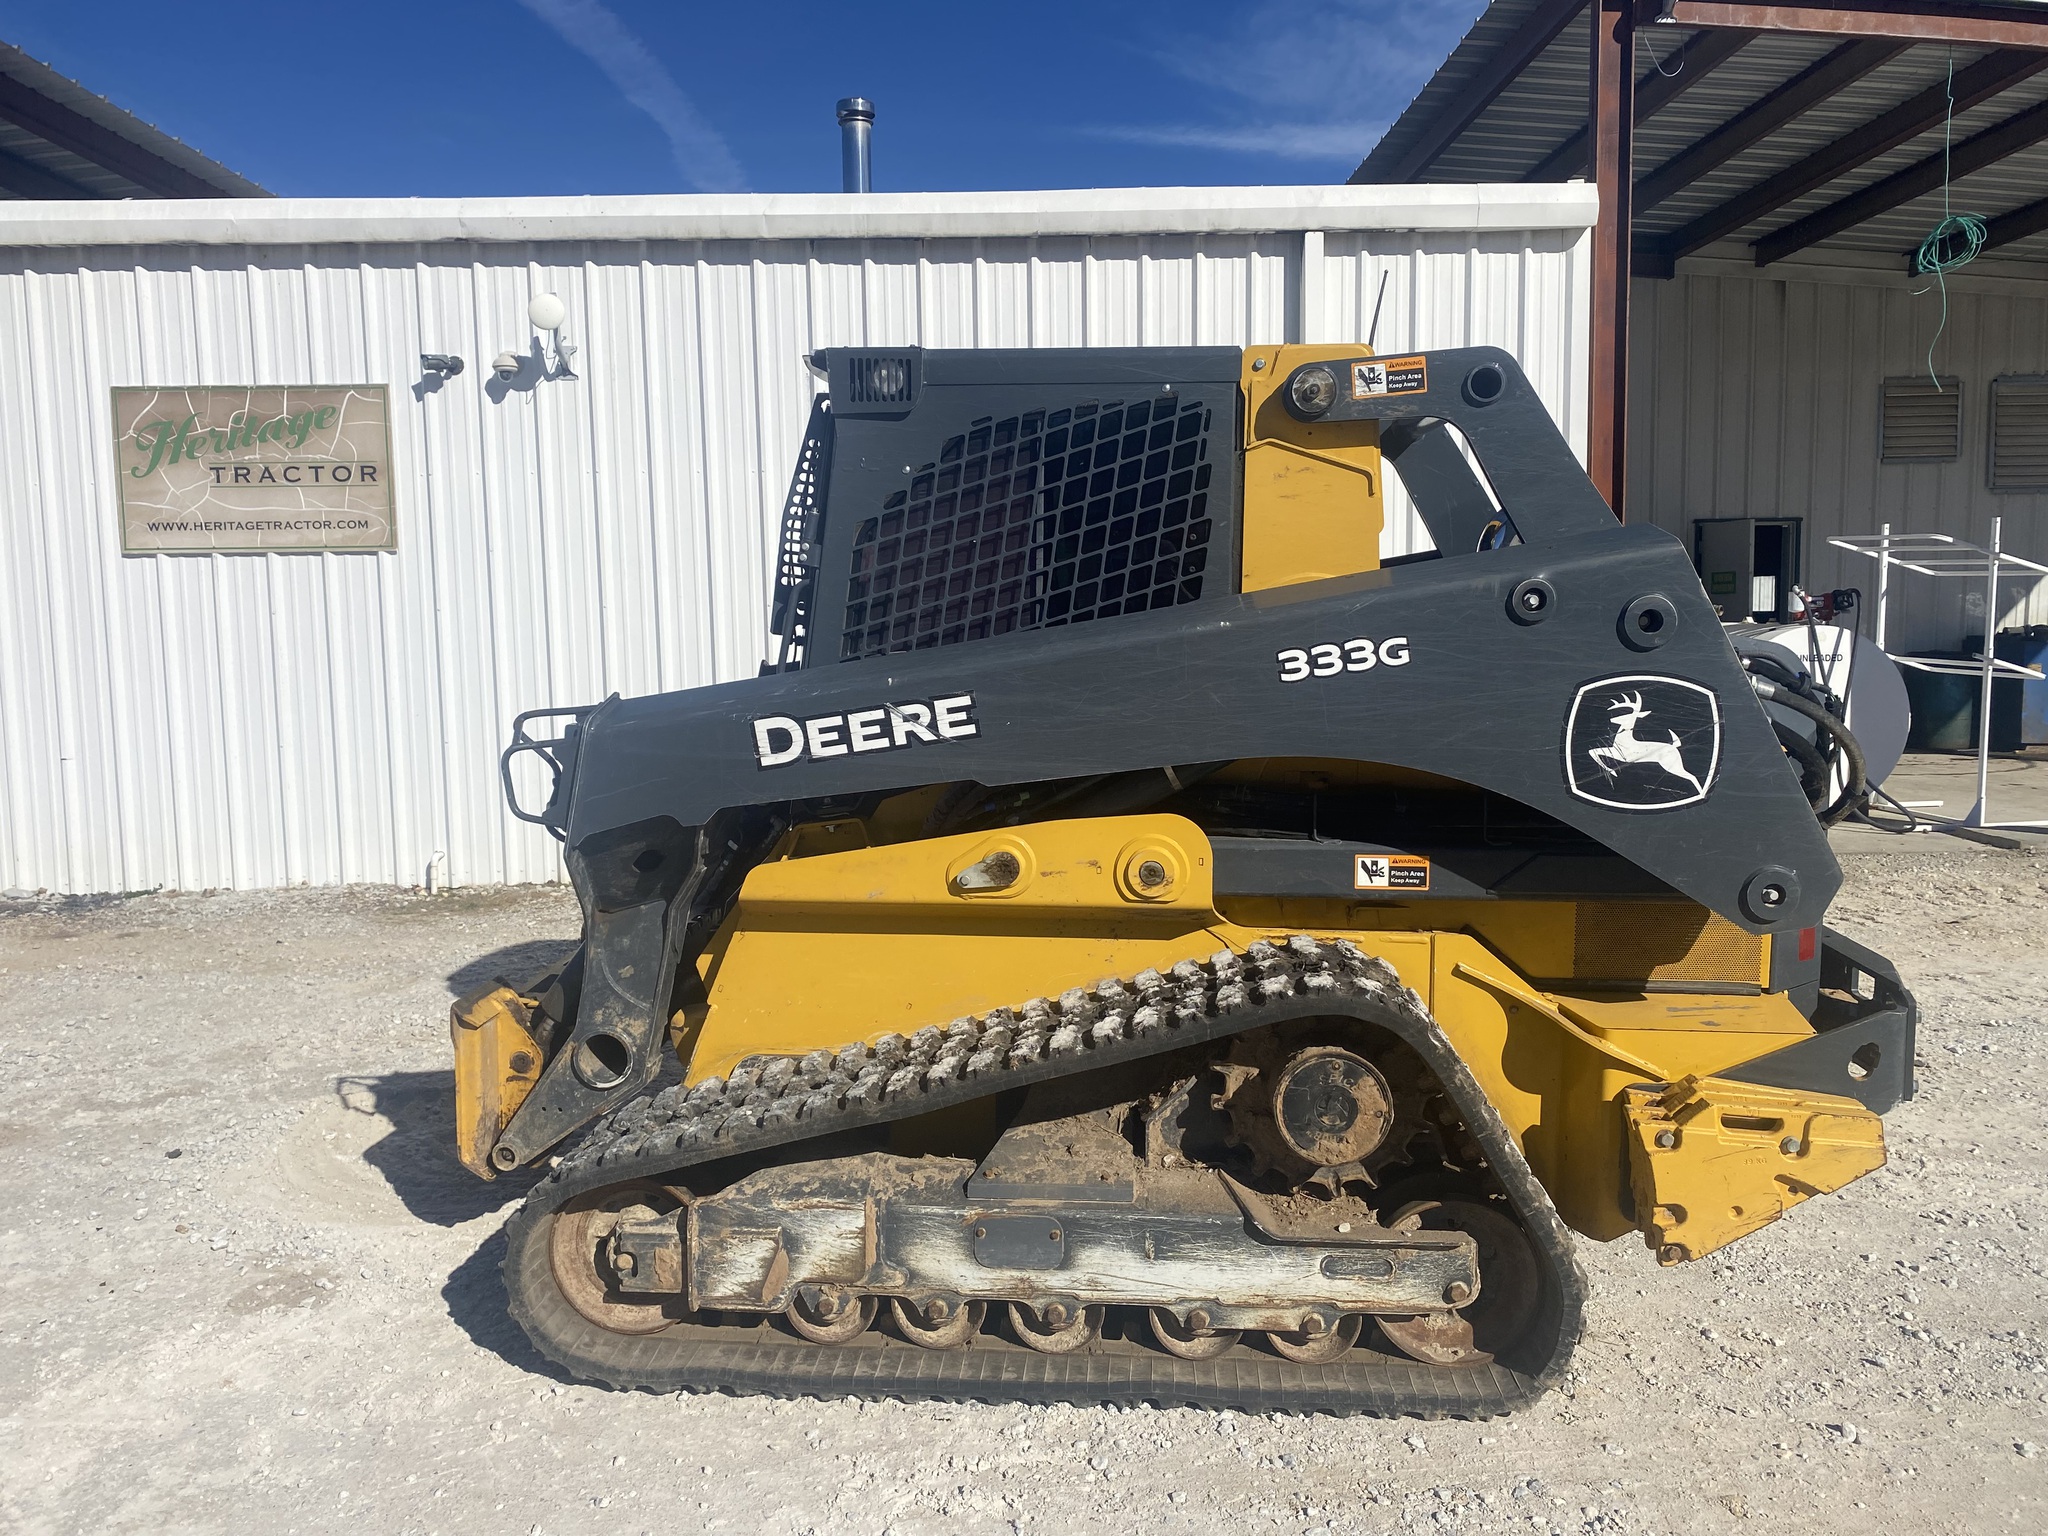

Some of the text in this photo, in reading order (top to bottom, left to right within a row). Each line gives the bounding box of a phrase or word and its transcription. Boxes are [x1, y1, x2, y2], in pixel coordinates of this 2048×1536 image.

[1394, 359, 1423, 368] WARNING
[1388, 374, 1407, 382] Pinch
[130, 405, 340, 479] Heritage
[209, 465, 377, 484] TRACTOR
[147, 519, 369, 532] WWW.HERITAGETRACTOR.COM
[1277, 637, 1410, 682] 333G
[753, 695, 977, 767] DEERE
[1405, 877, 1420, 885] Away
